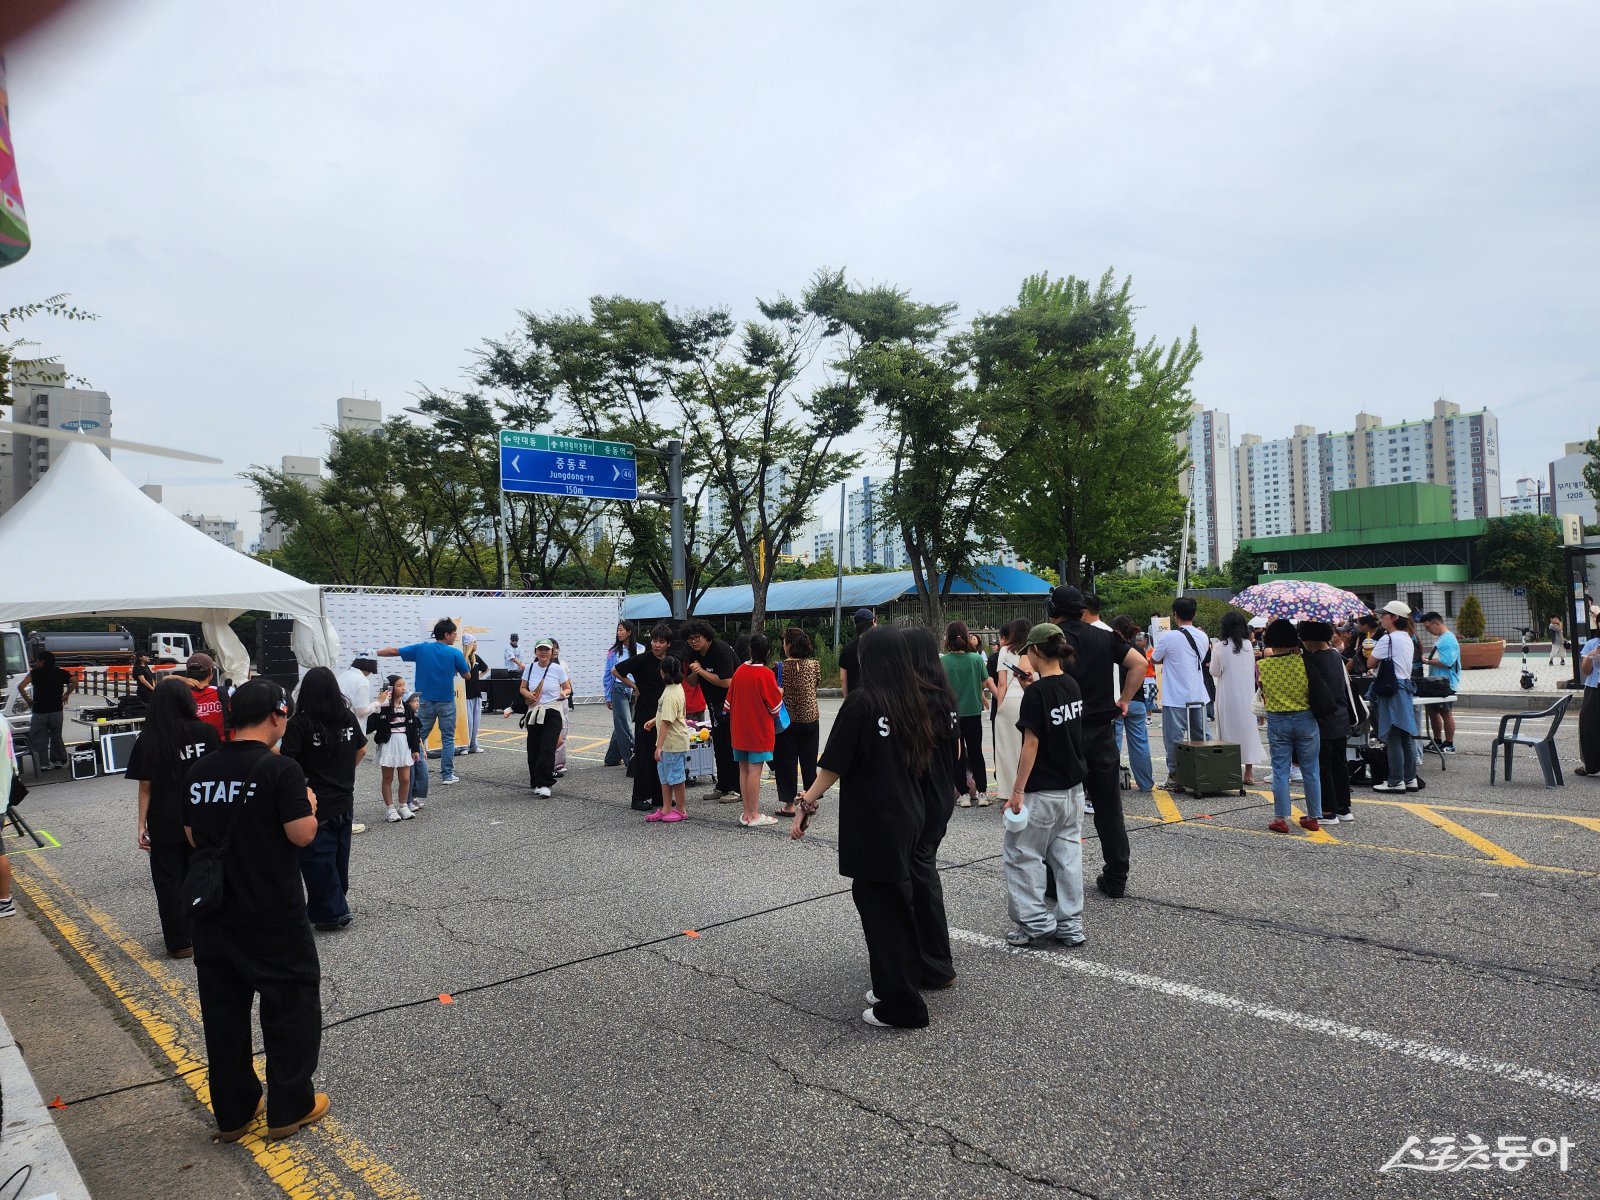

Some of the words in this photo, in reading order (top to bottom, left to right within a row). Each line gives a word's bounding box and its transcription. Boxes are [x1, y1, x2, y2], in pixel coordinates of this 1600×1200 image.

[604, 446, 625, 456] 중동역
[556, 457, 588, 471] 중동로
[549, 470, 595, 482] Jungdong-ro
[623, 470, 632, 478] 46
[565, 485, 584, 495] 150m
